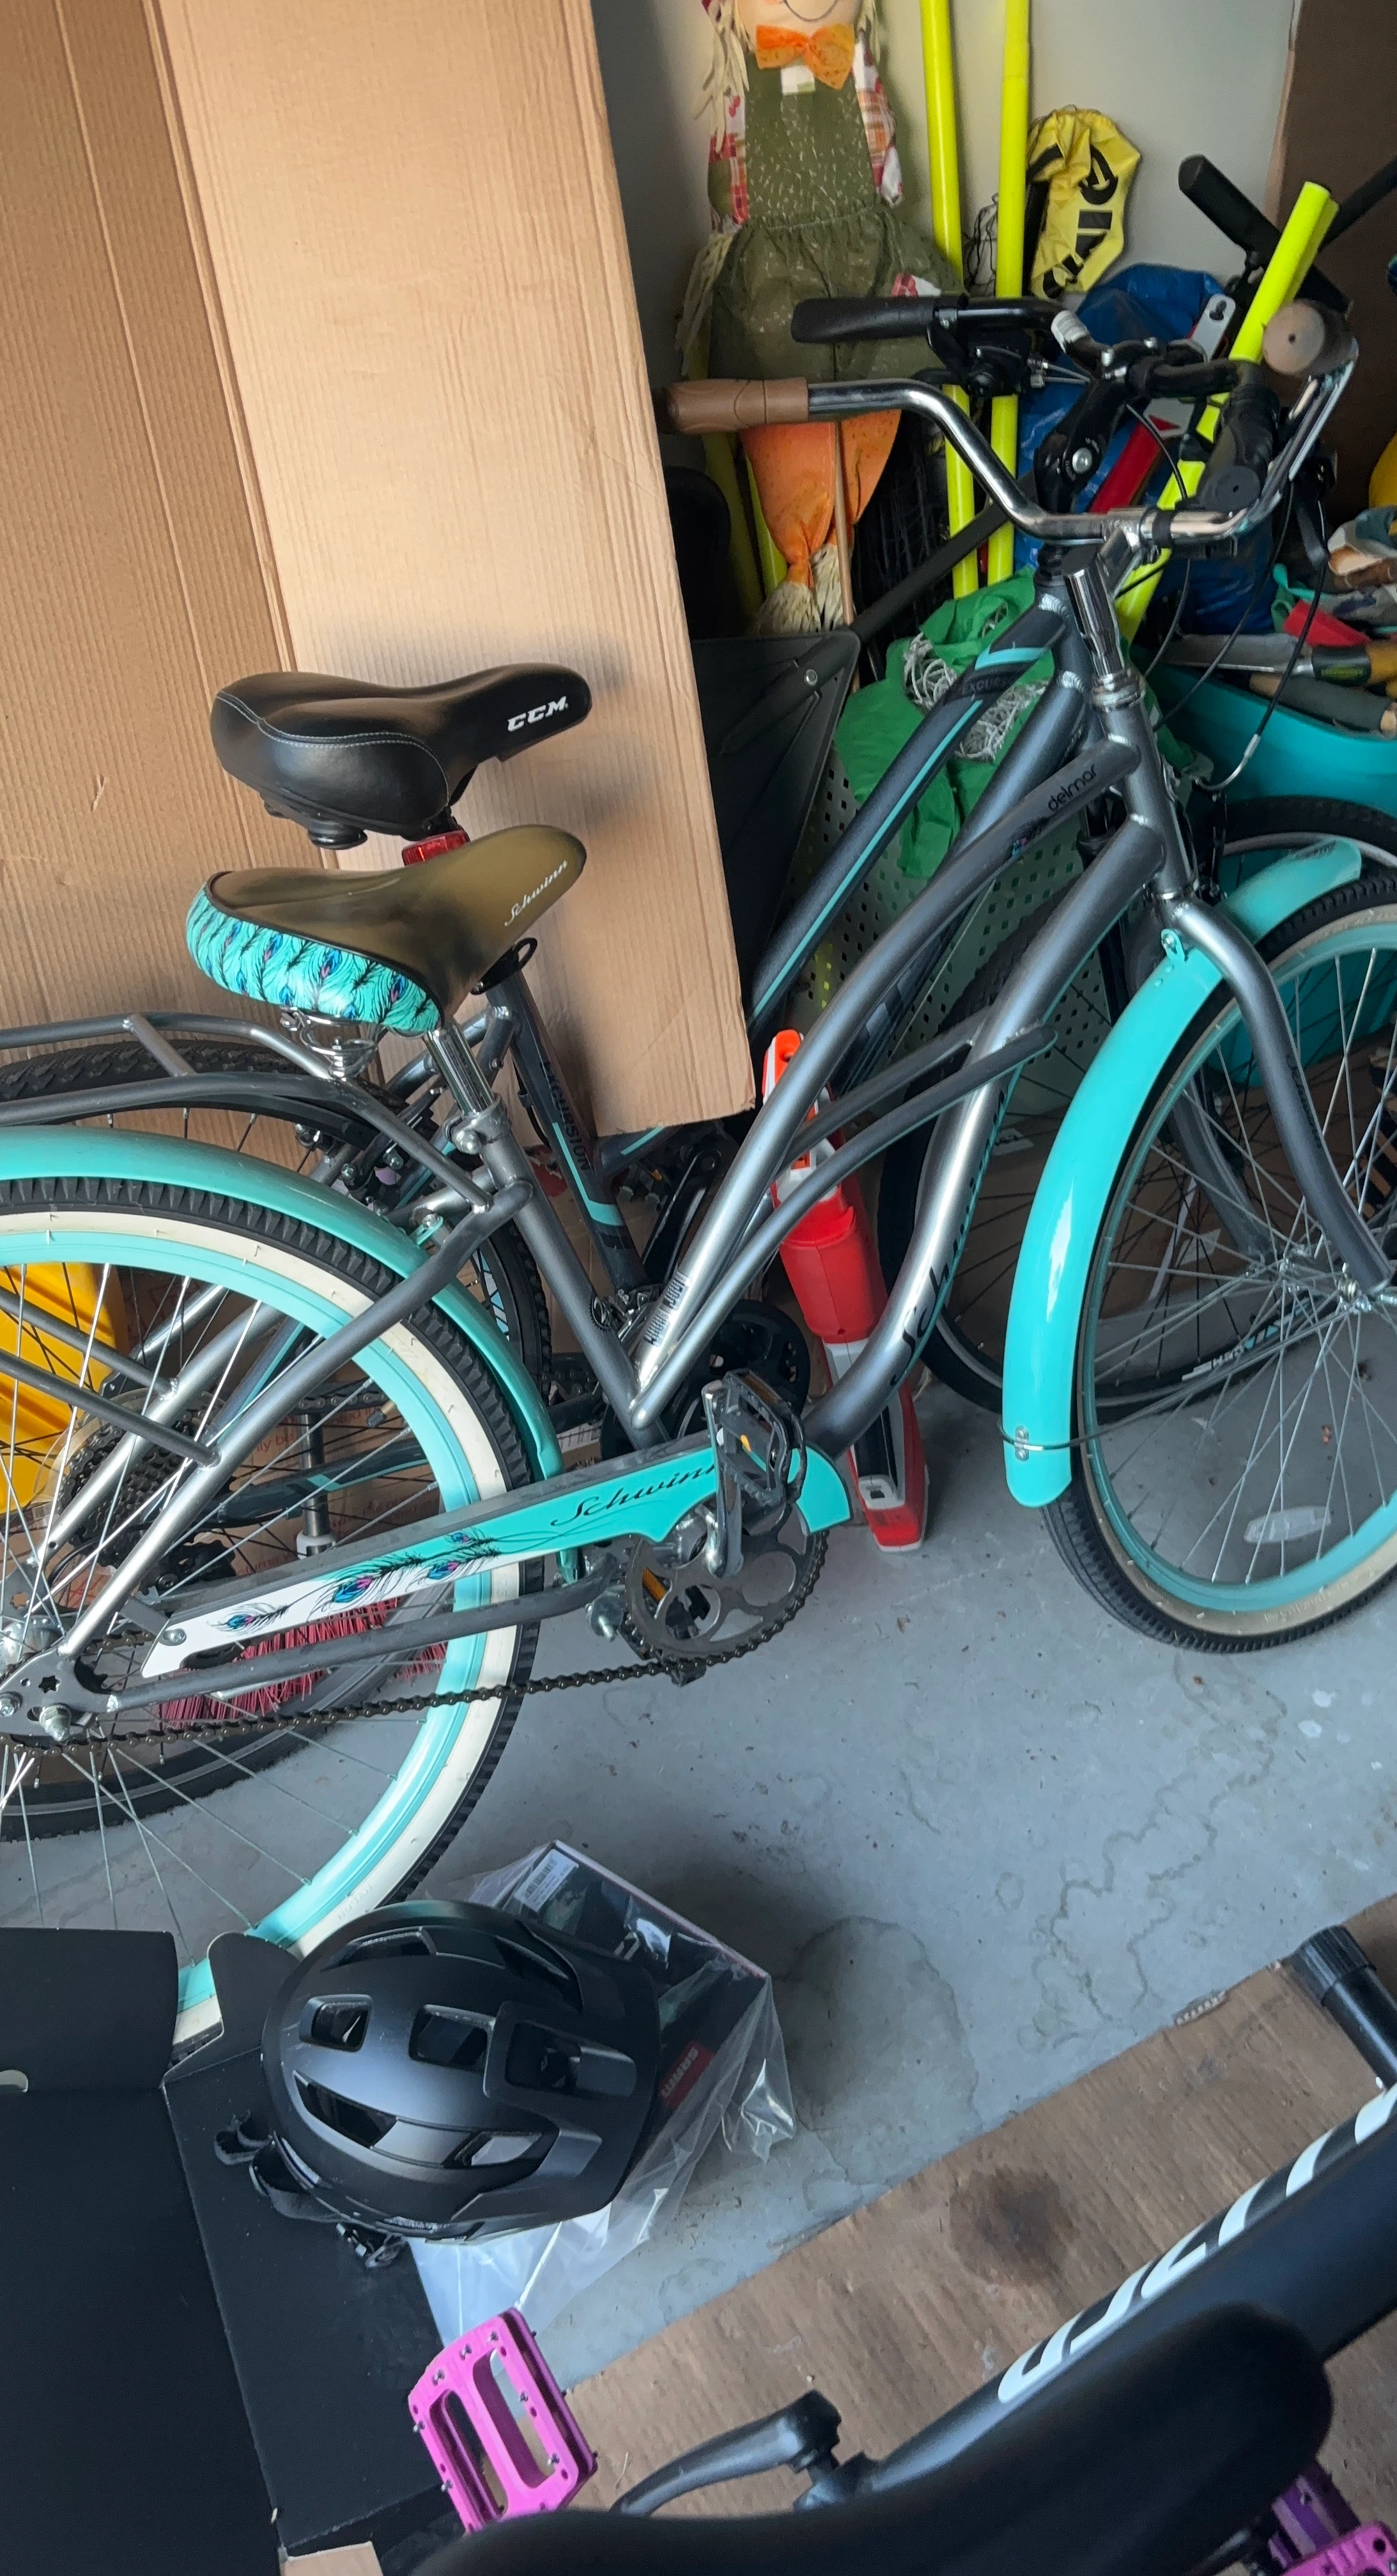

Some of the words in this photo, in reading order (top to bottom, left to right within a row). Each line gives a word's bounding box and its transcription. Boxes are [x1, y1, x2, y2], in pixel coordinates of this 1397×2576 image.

[507, 695, 567, 732] CCM
[1047, 763, 1097, 812] delmar
[504, 859, 568, 927] Schwinn
